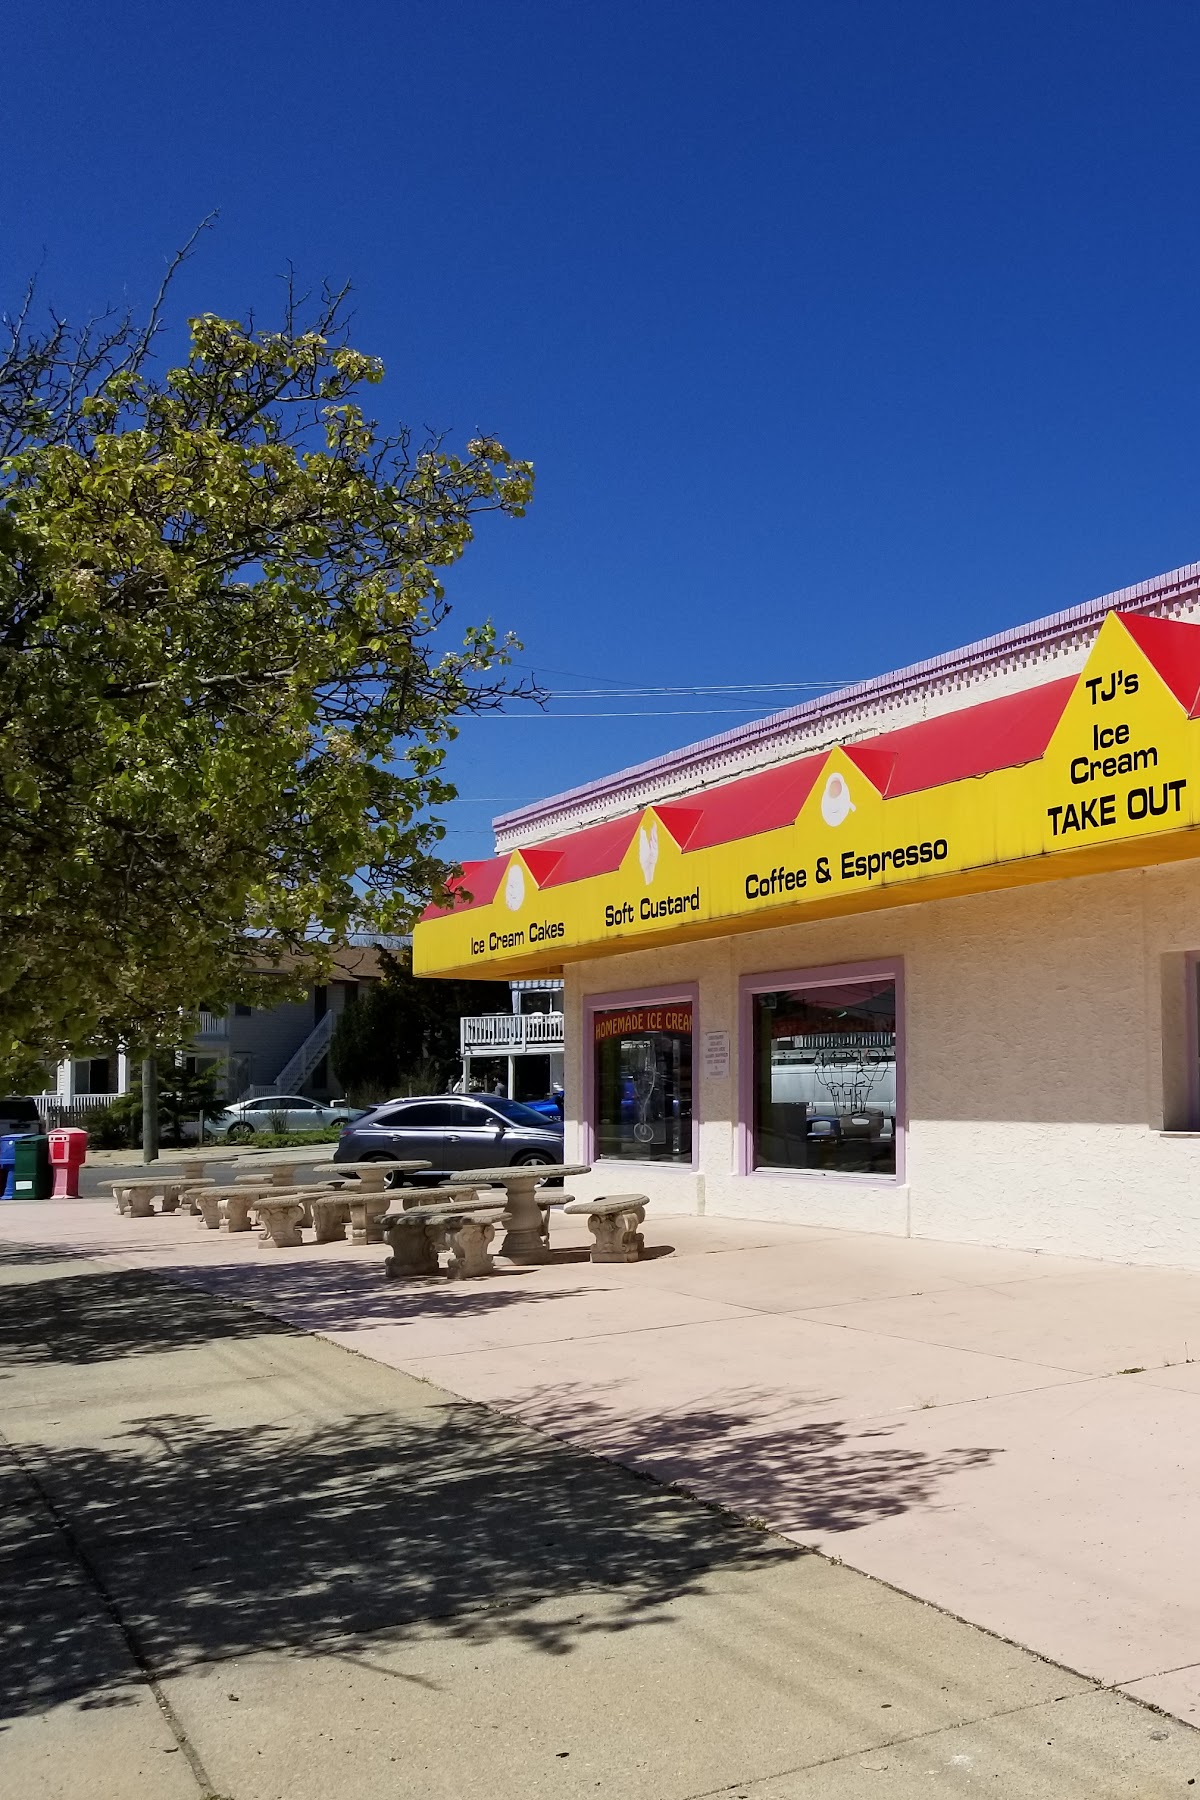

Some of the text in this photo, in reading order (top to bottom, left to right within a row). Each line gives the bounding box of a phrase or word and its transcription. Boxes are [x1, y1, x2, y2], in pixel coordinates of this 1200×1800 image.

[1086, 670, 1139, 705] TJ's
[1093, 724, 1129, 751] Ice
[1070, 747, 1158, 784] Cream
[1047, 779, 1187, 836] TAKE OUT
[745, 839, 948, 899] Coffee & Espresso
[605, 886, 700, 927] Soft Custard
[471, 920, 565, 955] Ice Cream Cakes
[595, 1013, 644, 1040] HOMEMADE
[647, 1012, 663, 1030] ICE
